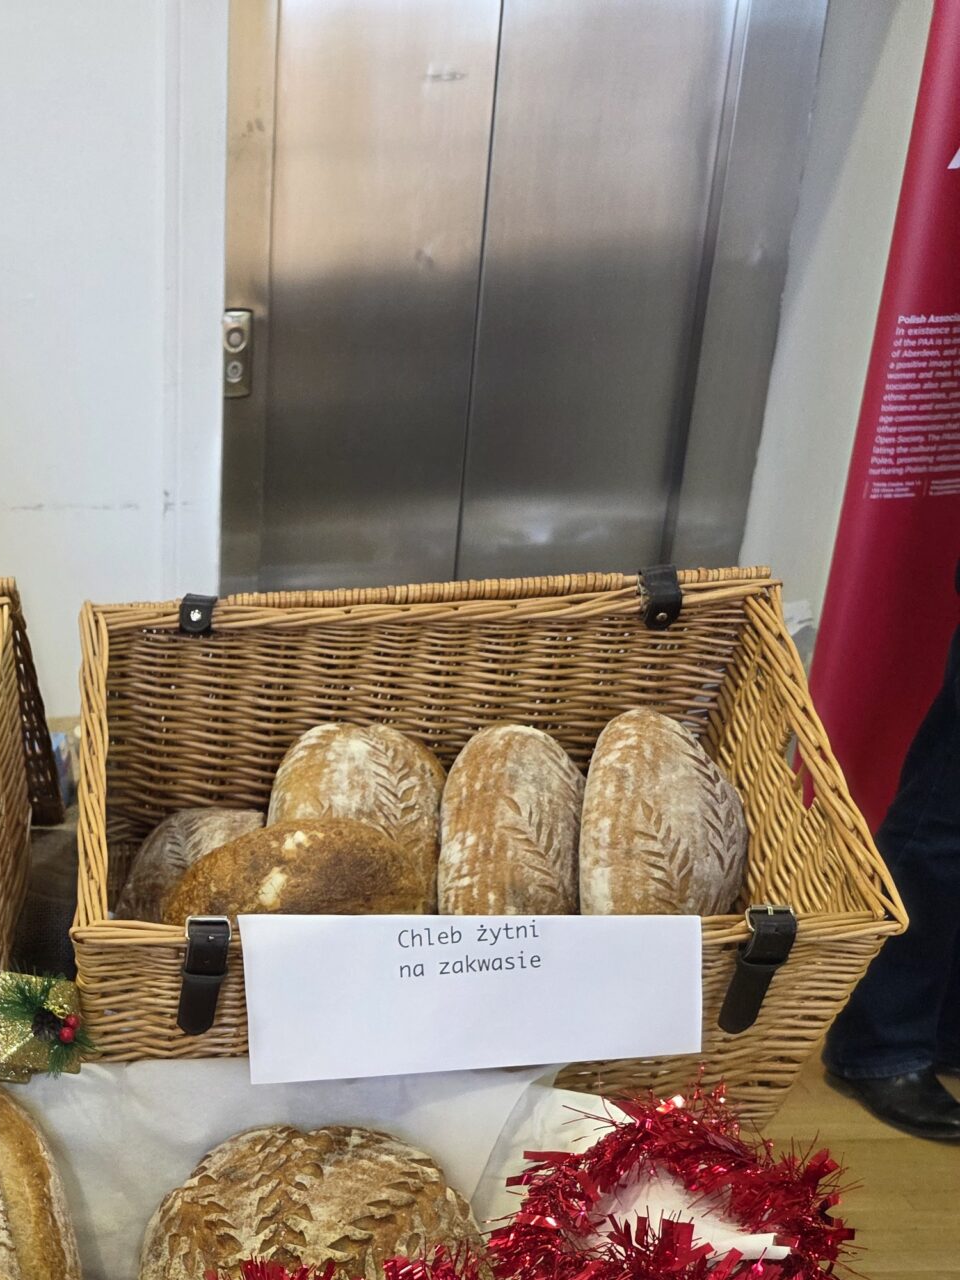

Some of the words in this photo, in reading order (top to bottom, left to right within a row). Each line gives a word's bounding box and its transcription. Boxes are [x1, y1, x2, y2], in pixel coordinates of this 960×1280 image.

[397, 925, 463, 949] Chleb
[475, 920, 540, 947] żytni
[399, 963, 425, 979] na
[438, 951, 542, 976] zakwasie
